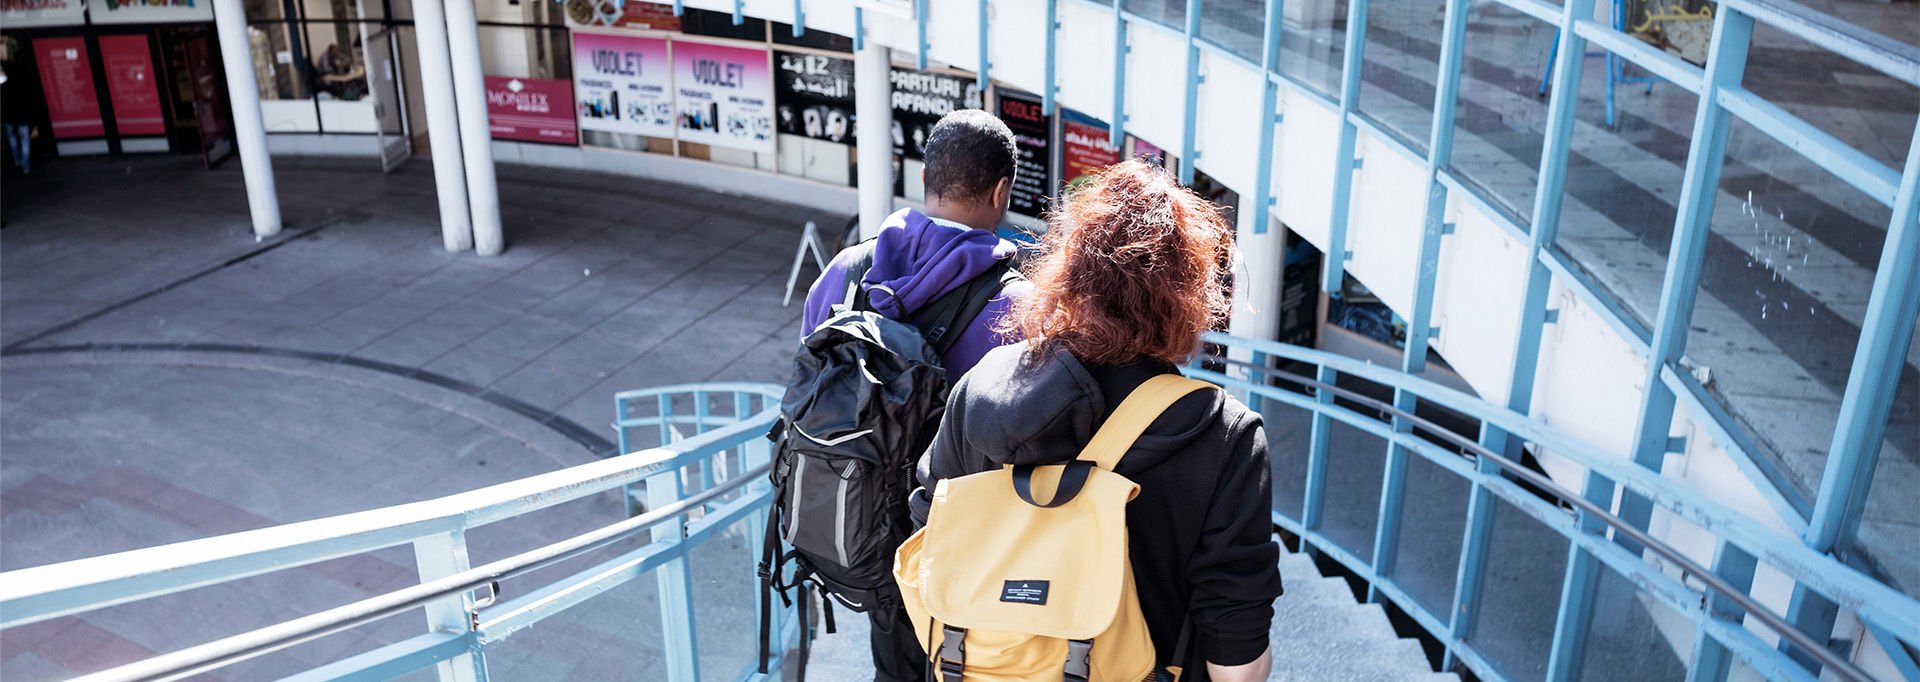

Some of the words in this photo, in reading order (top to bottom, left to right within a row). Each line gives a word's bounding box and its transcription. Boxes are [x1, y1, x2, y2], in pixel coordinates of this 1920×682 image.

[592, 48, 643, 77] VIOLET
[692, 58, 744, 89] VIOLET
[891, 91, 954, 115] AFANDI
